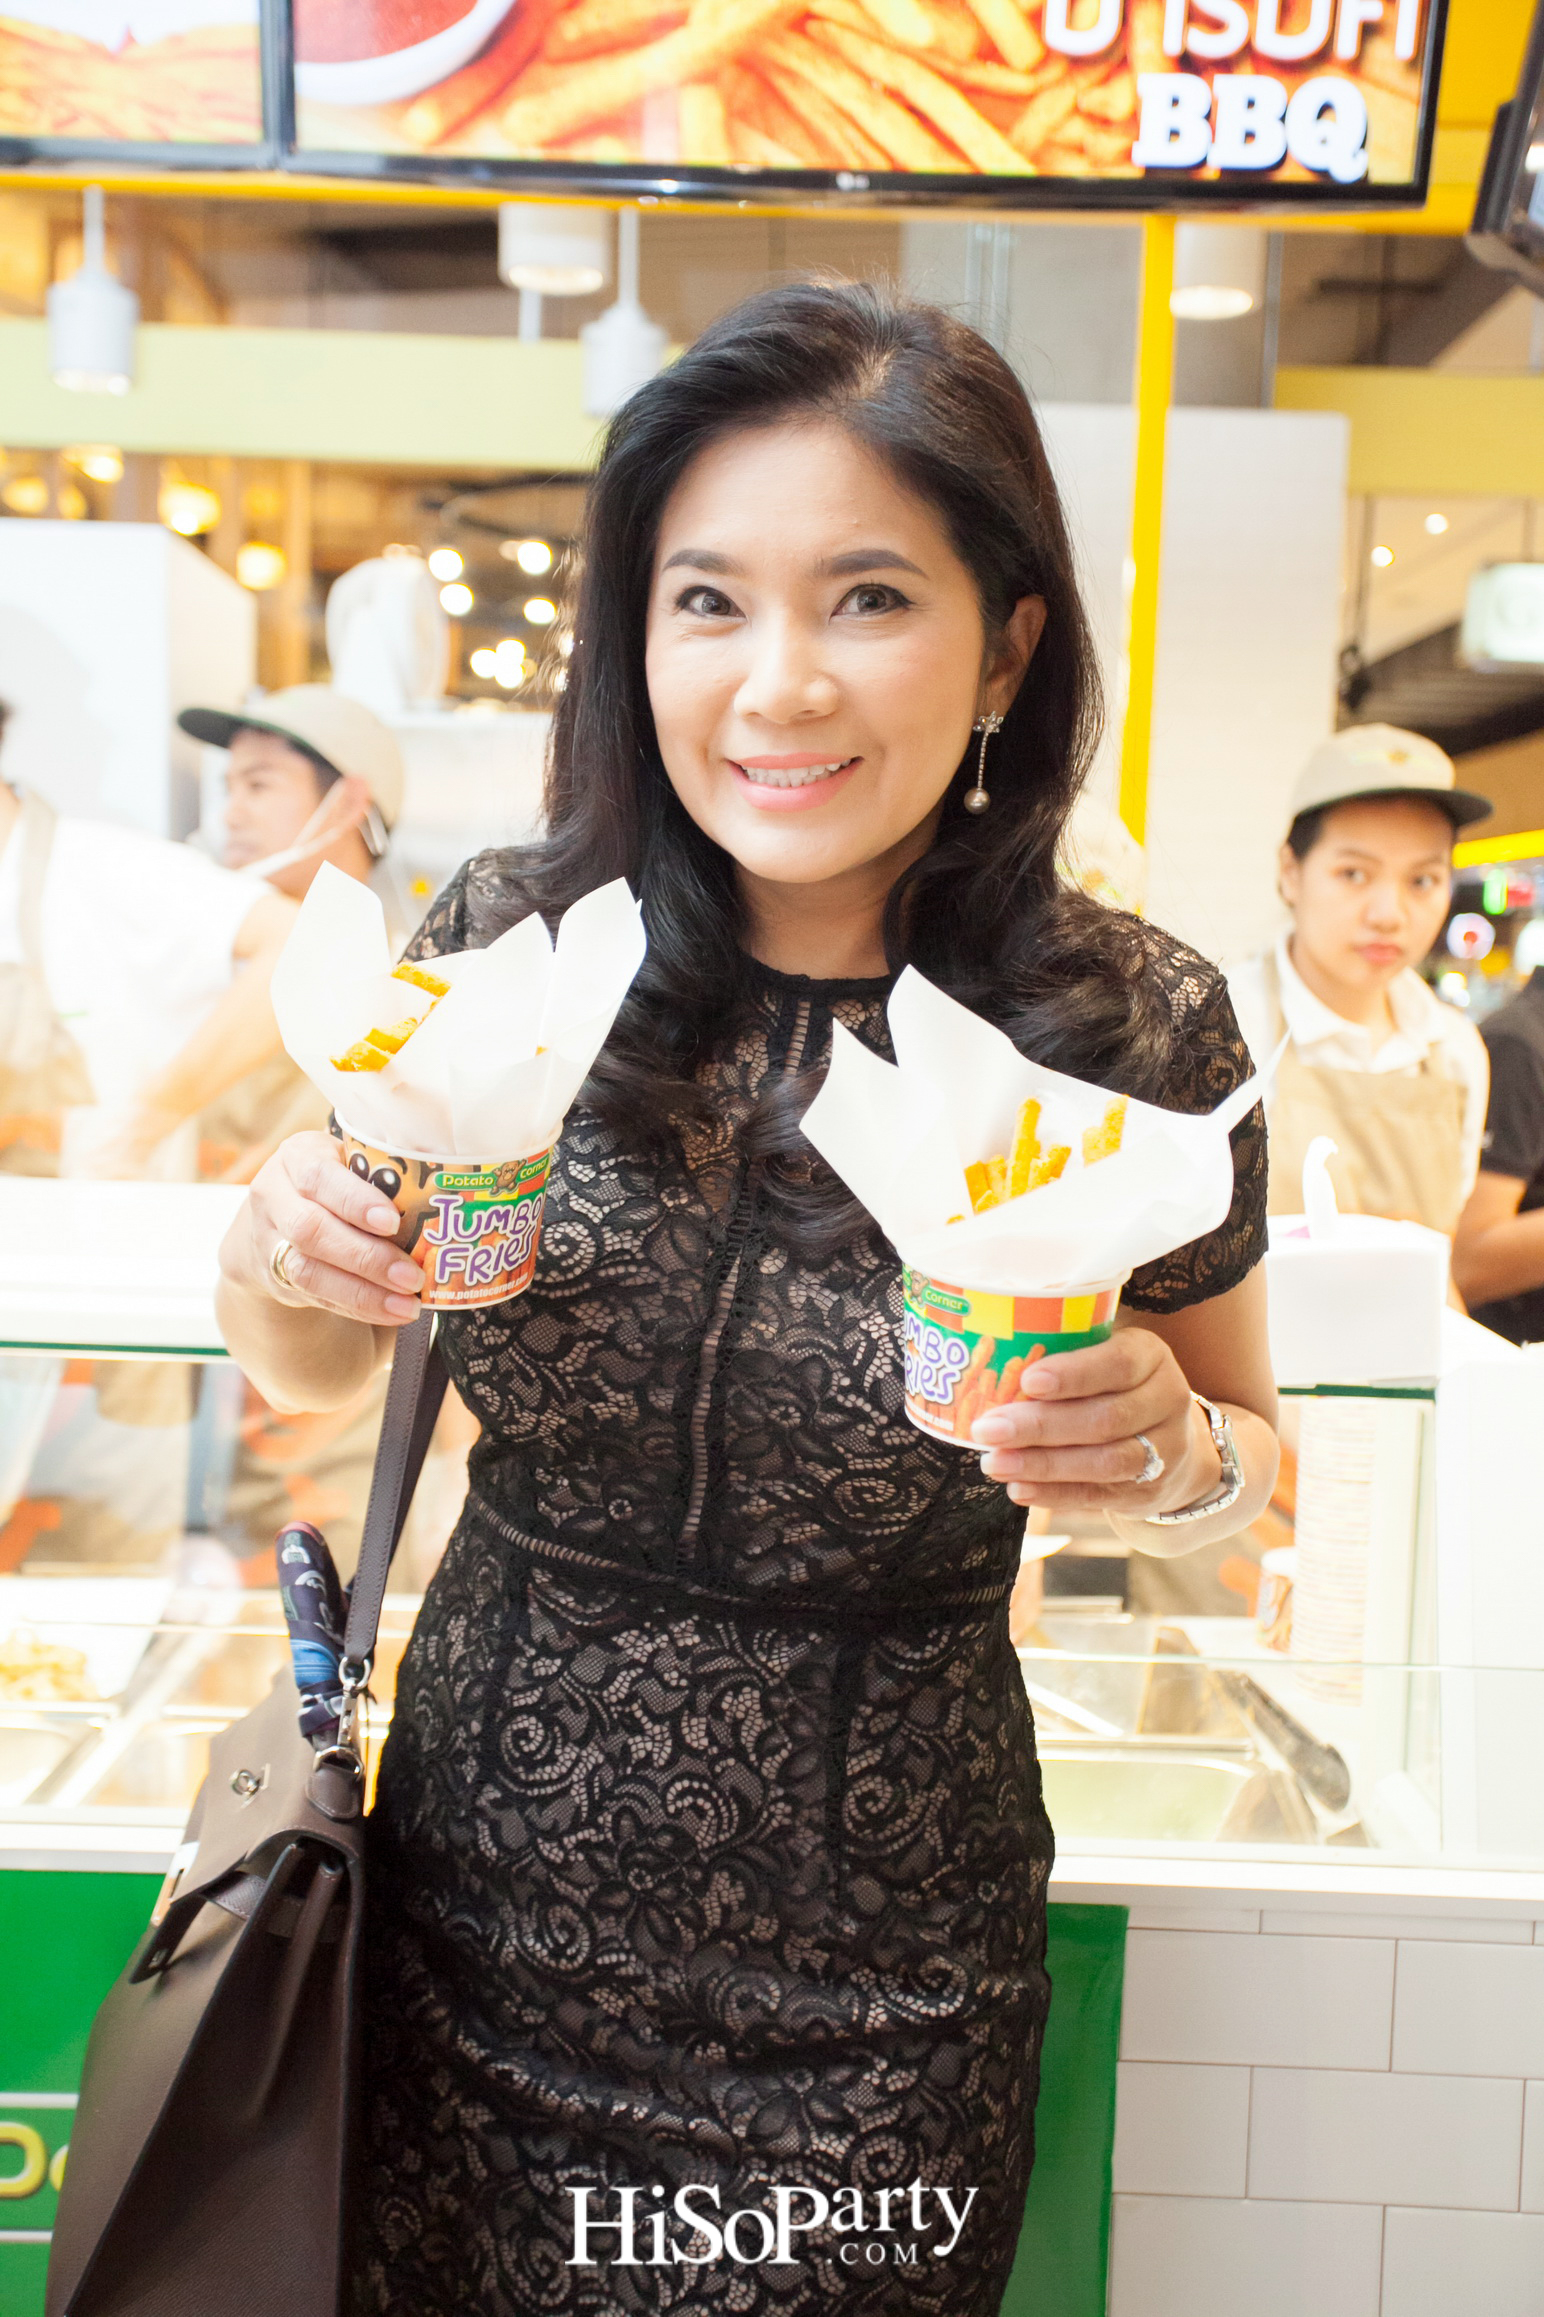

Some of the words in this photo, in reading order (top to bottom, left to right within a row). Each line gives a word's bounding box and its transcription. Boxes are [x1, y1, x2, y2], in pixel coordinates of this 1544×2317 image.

[1132, 73, 1368, 183] BBQ
[442, 1174, 494, 1187] Potato
[905, 1314, 966, 1367] MBO
